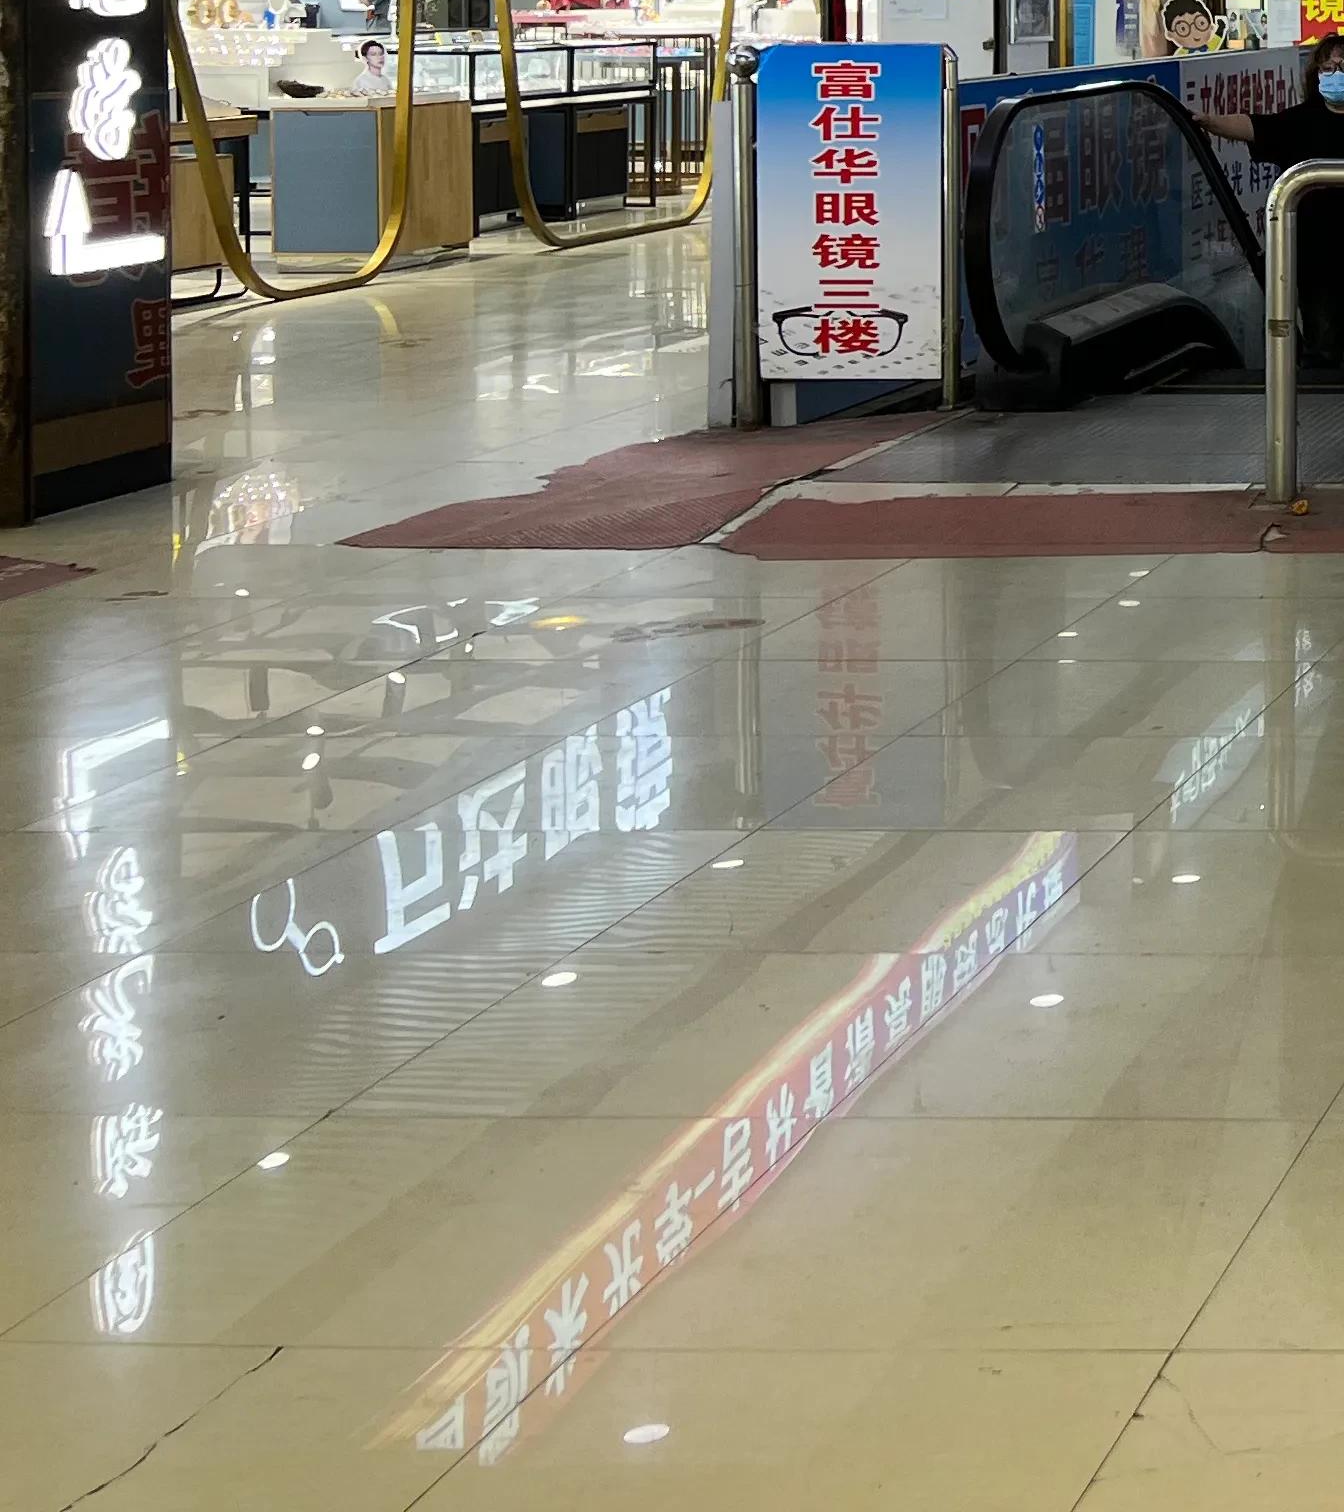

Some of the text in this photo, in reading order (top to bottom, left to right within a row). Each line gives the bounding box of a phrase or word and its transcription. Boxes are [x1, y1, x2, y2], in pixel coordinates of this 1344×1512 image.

[810, 60, 881, 355] 富仕华眼镜三楼
